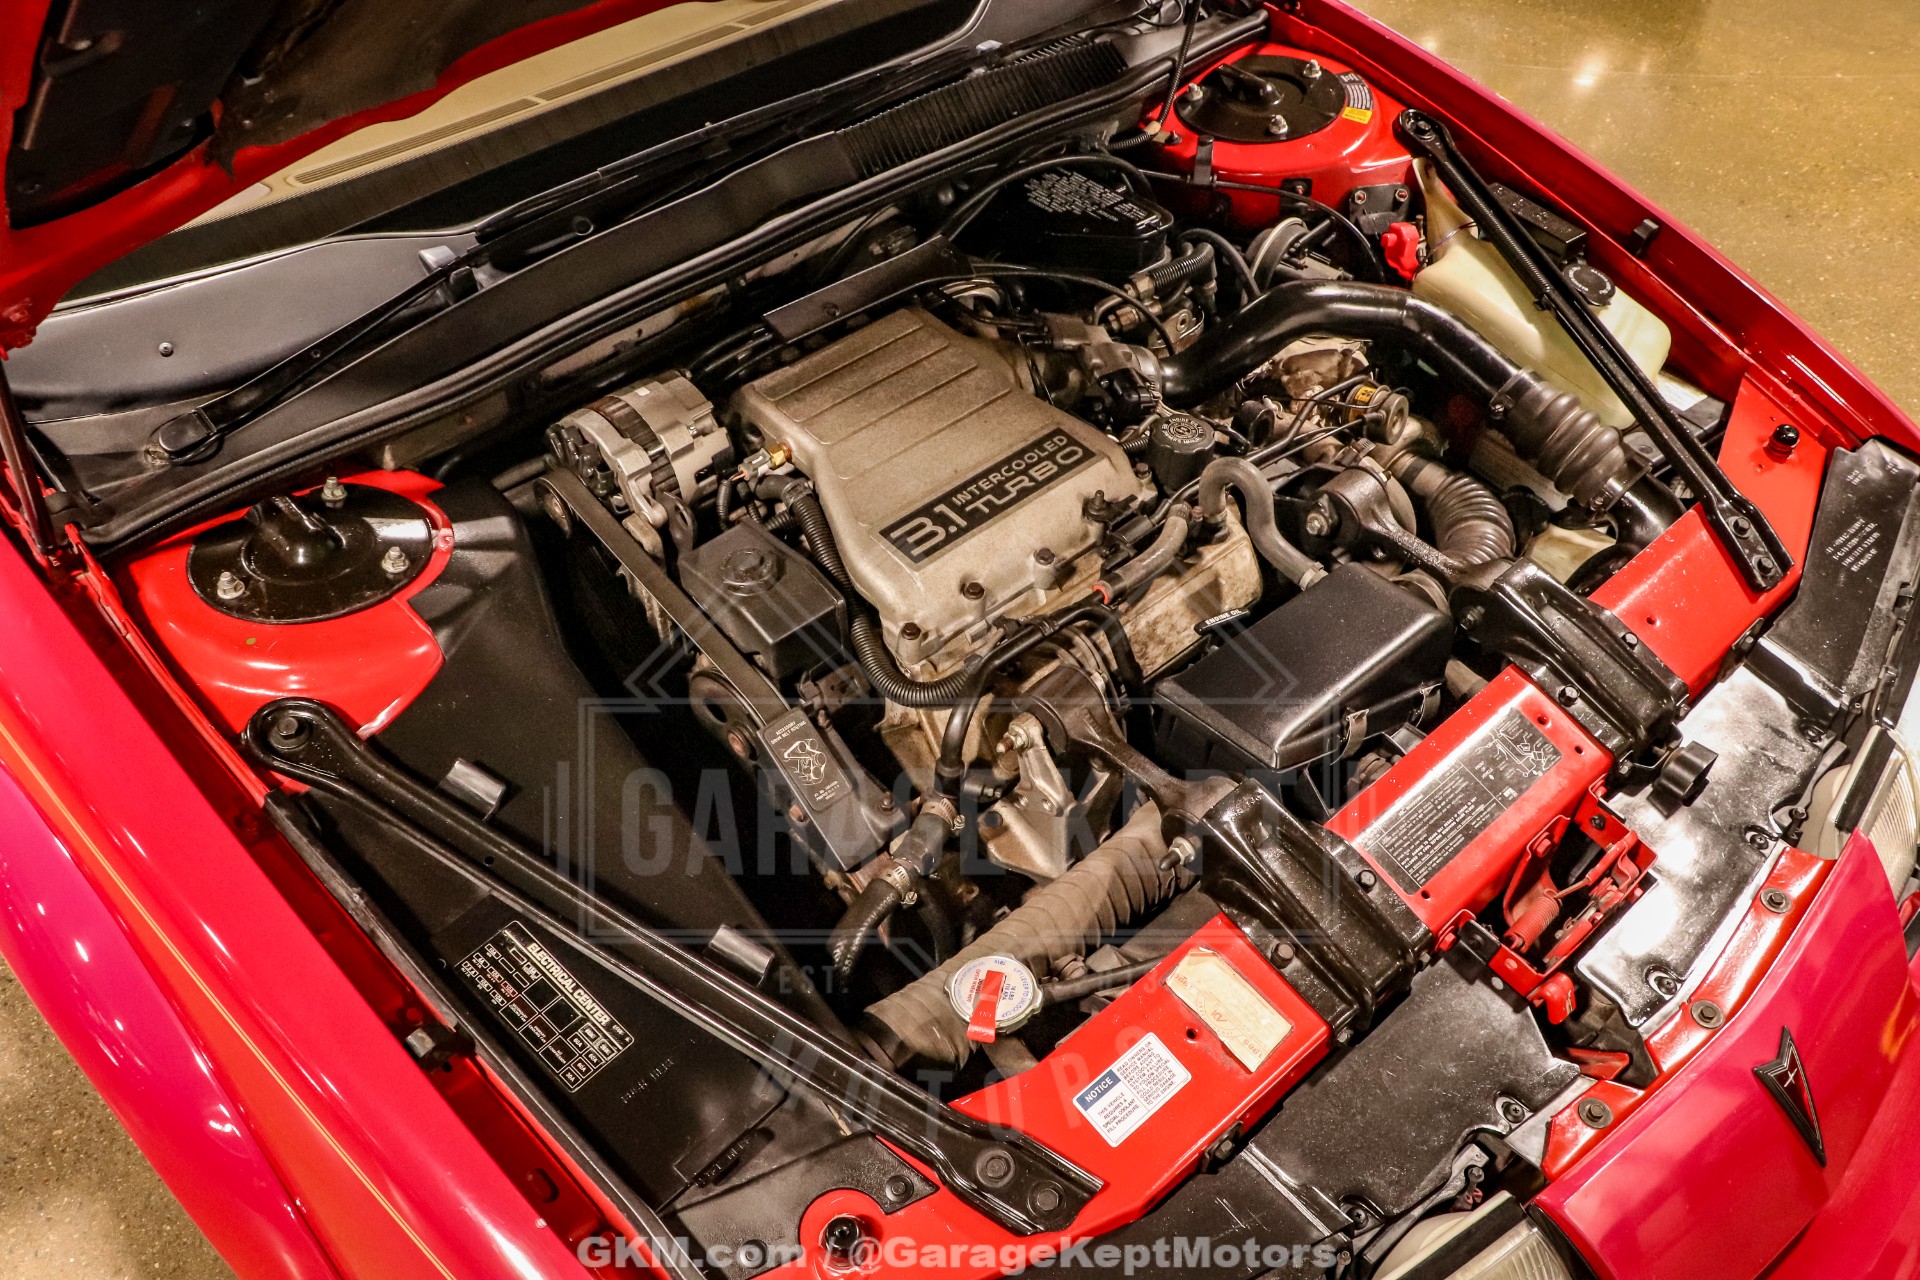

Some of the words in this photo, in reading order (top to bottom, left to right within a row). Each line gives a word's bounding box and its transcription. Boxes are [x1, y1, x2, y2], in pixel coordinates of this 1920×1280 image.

[951, 435, 1069, 506] INTERCOOLED
[889, 503, 968, 557] 3.1
[965, 446, 1084, 515] TURBO
[1205, 612, 1231, 625] ENGINE
[1230, 608, 1242, 616] OIL
[526, 942, 578, 994] ELECTRICAL
[572, 989, 611, 1027] CENTER
[1116, 1061, 1129, 1073] READ
[1119, 1061, 1137, 1076] SERVICE
[1136, 1046, 1154, 1062] MANUAL
[1123, 1065, 1140, 1080] BEFORE
[1139, 1052, 1155, 1066] ADDING
[1126, 1075, 1136, 1084] ANY
[1135, 1059, 1155, 1076] COOLANT
[1139, 1072, 1155, 1086] FOLLOW
[1154, 1058, 1170, 1073] SPECIAL
[1146, 1057, 1164, 1073] FAILURE
[1084, 1076, 1114, 1103] NOTICE
[1137, 1086, 1146, 1095] FILL
[1145, 1065, 1170, 1087] PROCEDURE
[1140, 1086, 1154, 1099] COULD
[1153, 1073, 1168, 1087] RESULT
[1143, 1087, 1160, 1102] SERIOUS
[1159, 1073, 1176, 1088] DAMAGE
[1098, 1107, 1108, 1116] THIS
[1107, 1092, 1125, 1108] VEHICLE
[1153, 1093, 1161, 1101] THE
[1103, 1102, 1124, 1120] REQUIRES
[1103, 1114, 1119, 1129] SPECIAL
[1118, 1098, 1137, 1115] COOLANT
[1107, 1124, 1117, 1134] FILL
